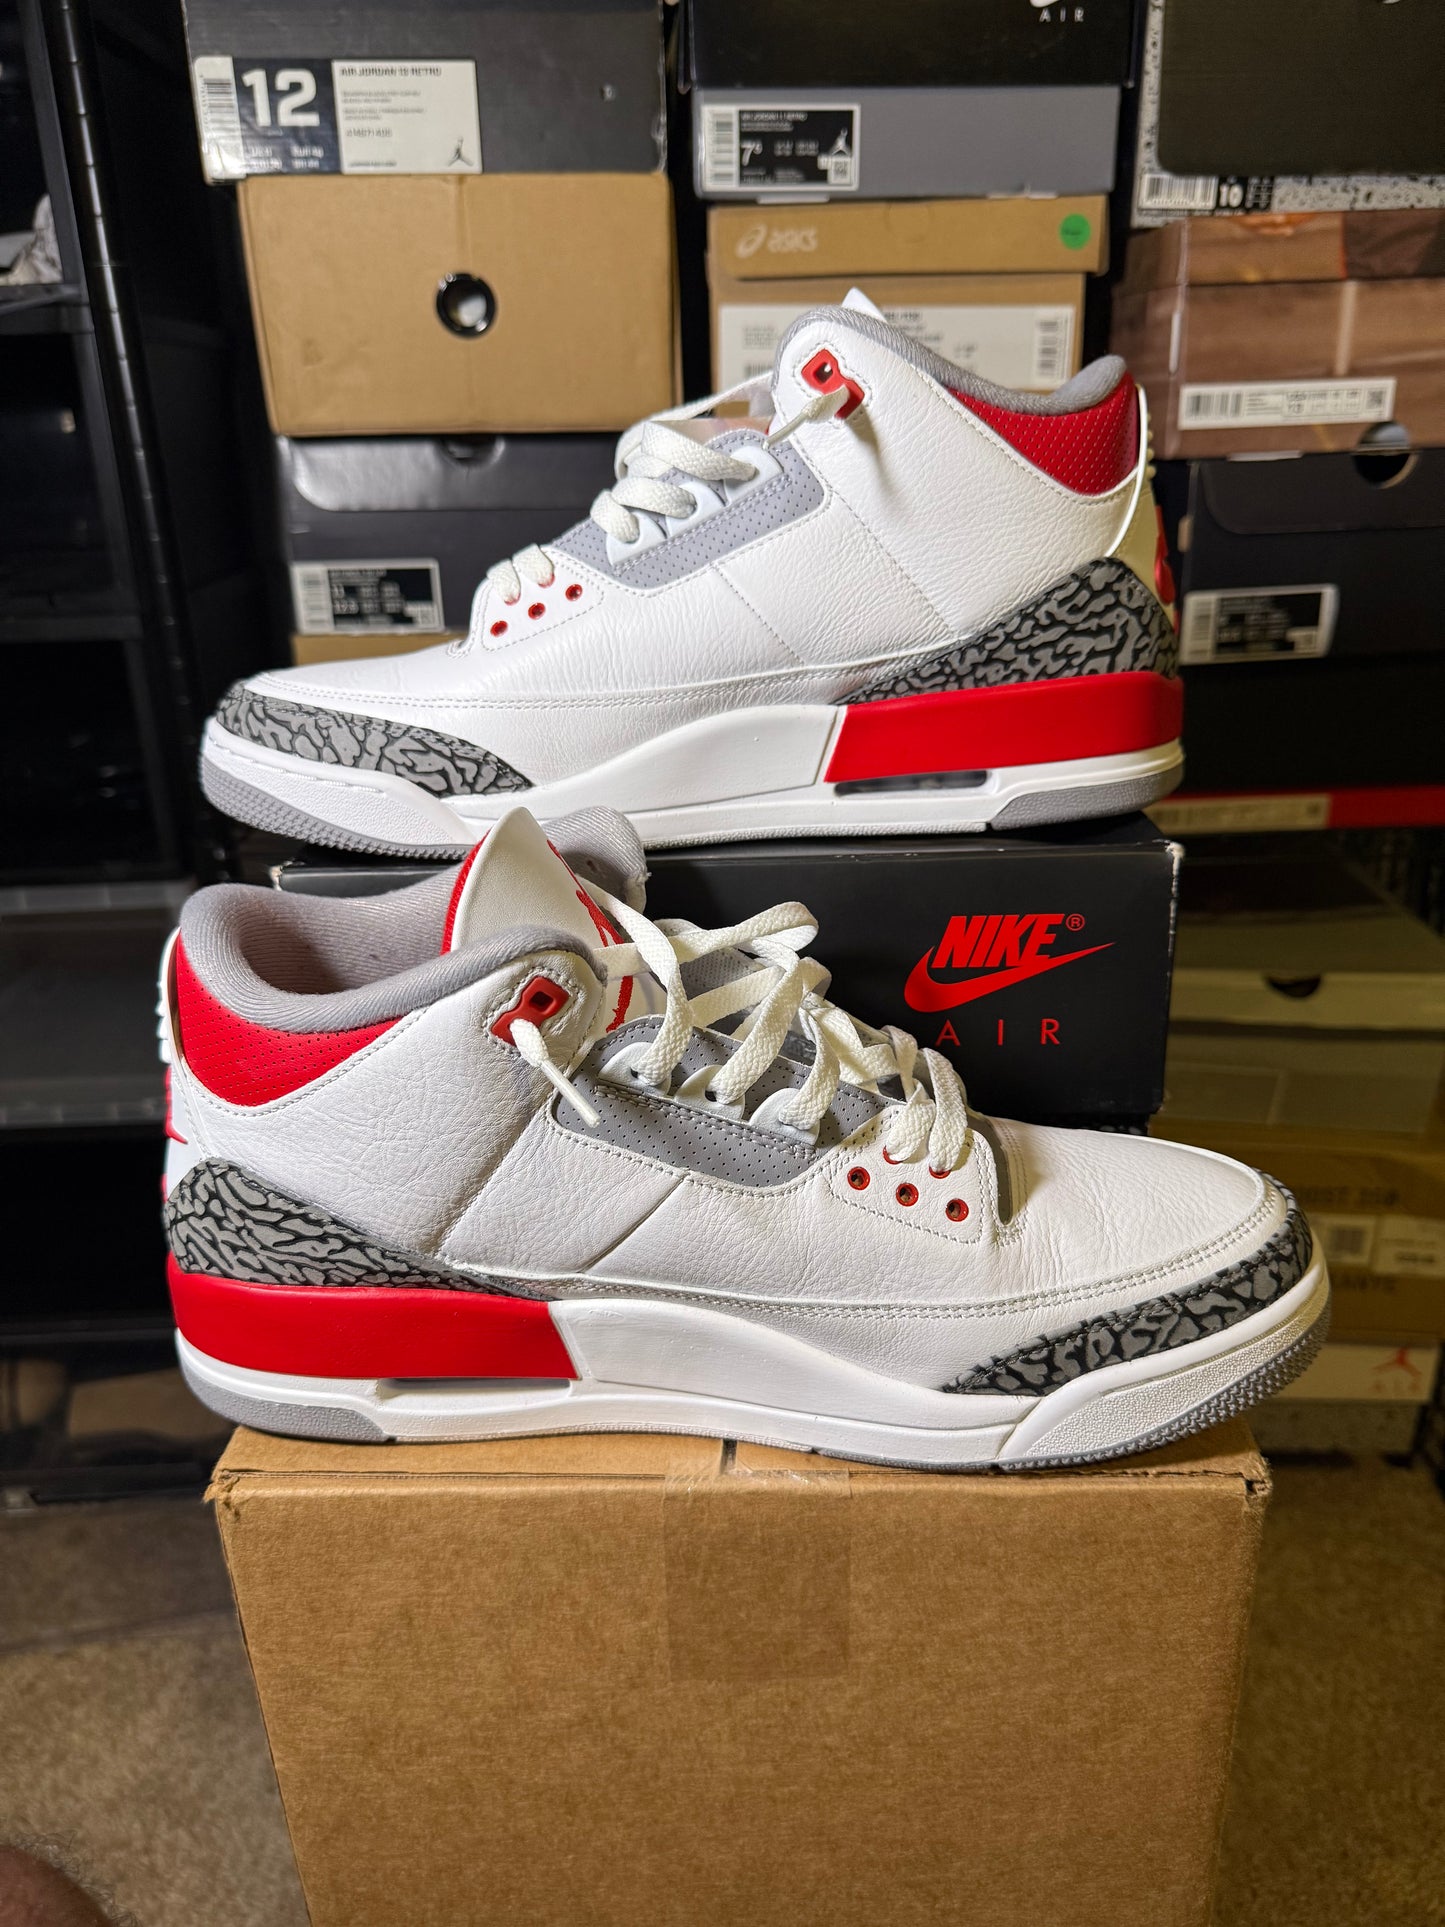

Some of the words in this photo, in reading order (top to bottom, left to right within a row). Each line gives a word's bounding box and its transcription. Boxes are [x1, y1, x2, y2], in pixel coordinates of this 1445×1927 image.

[1039, 8, 1084, 22] AIR
[241, 68, 321, 127] 12
[1219, 183, 1244, 207] 10
[931, 914, 1066, 968] NIKE
[935, 1019, 1060, 1046] AIR
